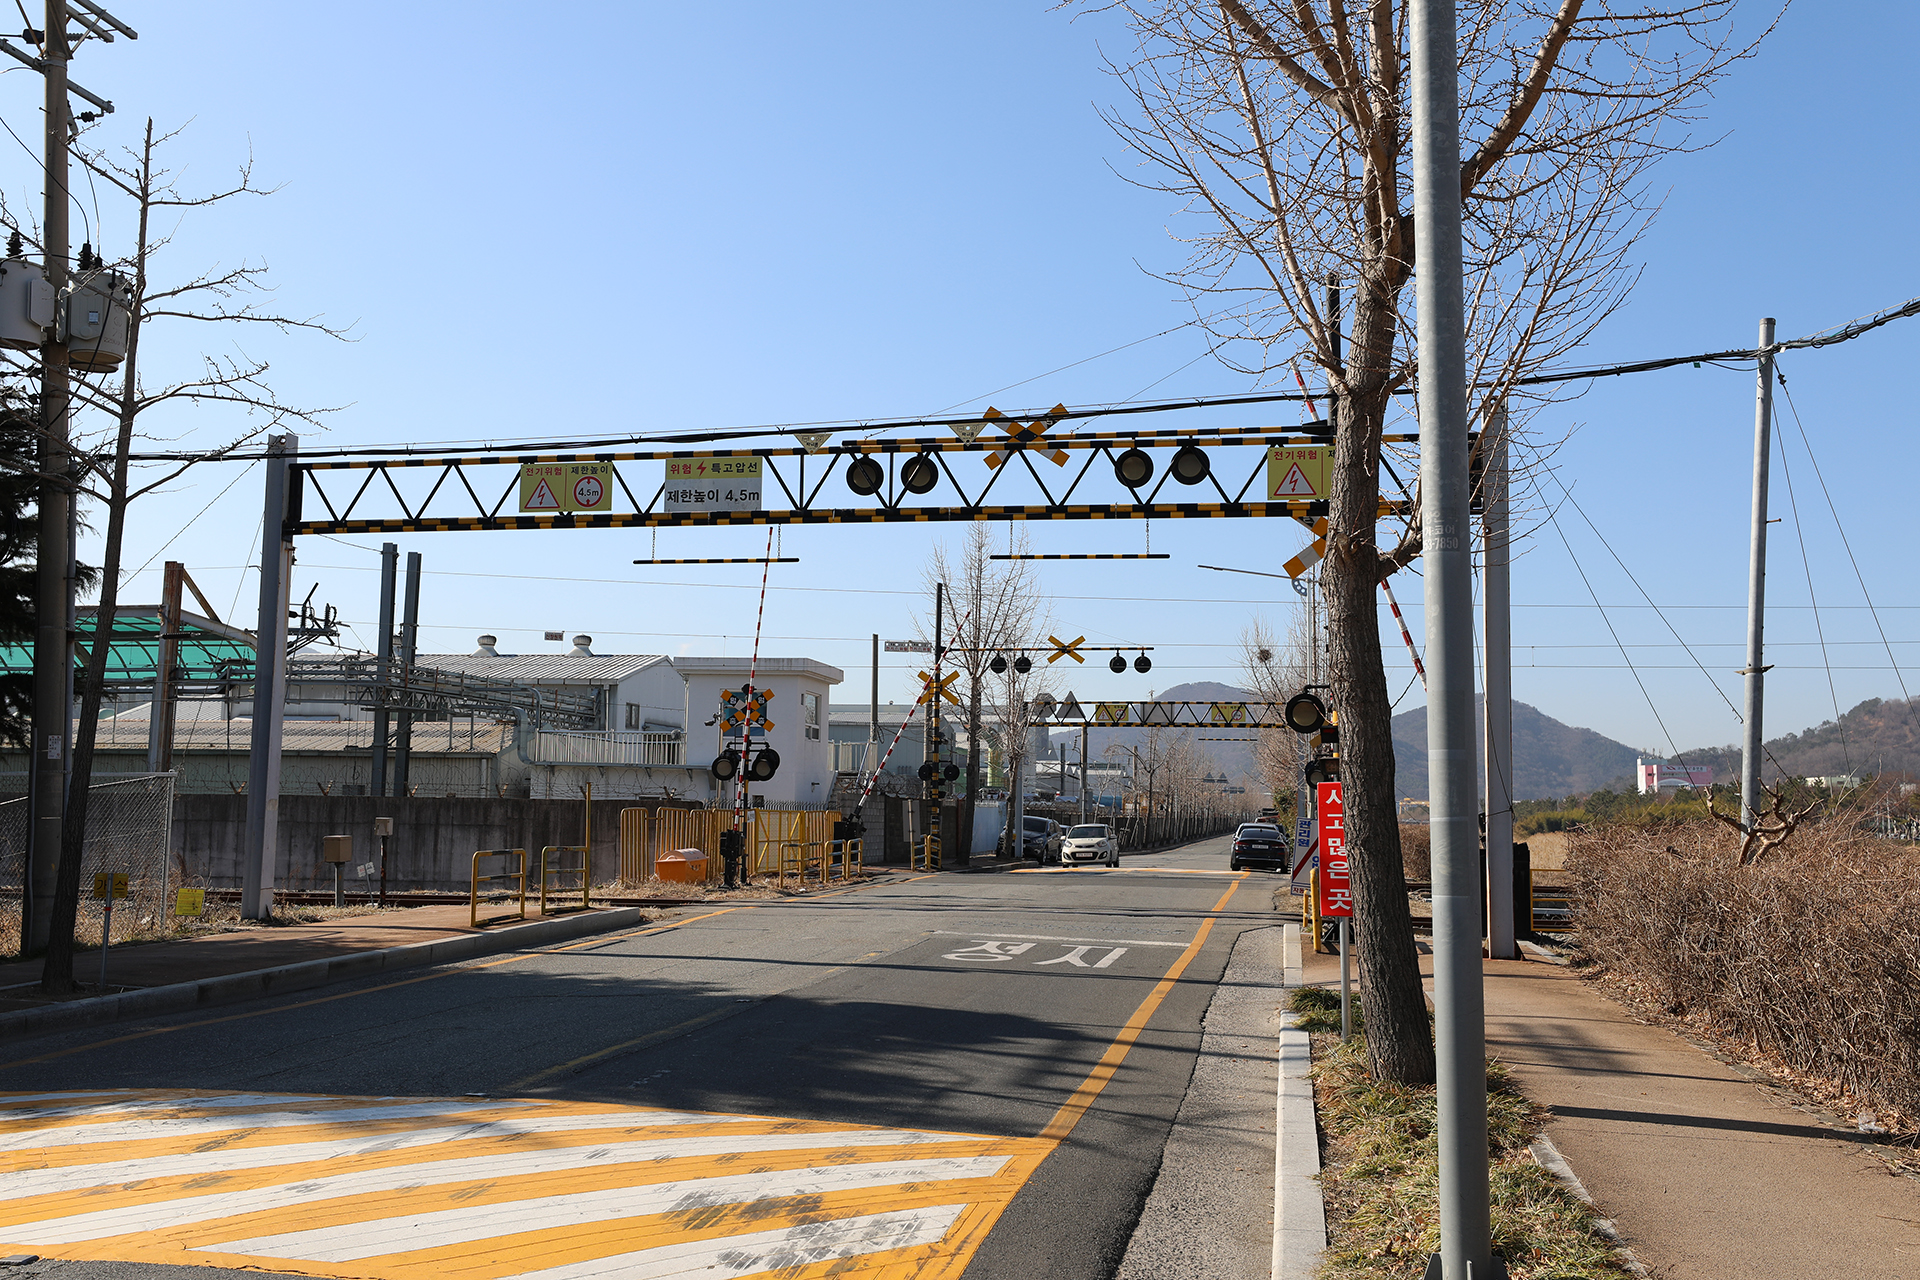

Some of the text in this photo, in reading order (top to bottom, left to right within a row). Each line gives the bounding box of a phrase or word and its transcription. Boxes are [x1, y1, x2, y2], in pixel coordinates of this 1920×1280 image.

[1273, 449, 1318, 461] 전기위험
[524, 466, 563, 477] 전기위험
[570, 465, 609, 476] 제한높이
[670, 461, 758, 475] 위험 특고압선
[578, 487, 600, 498] 4.5m
[666, 488, 760, 503] 제한높이 4.5m
[96, 879, 125, 891] 가스
[940, 939, 1129, 969] 정지
